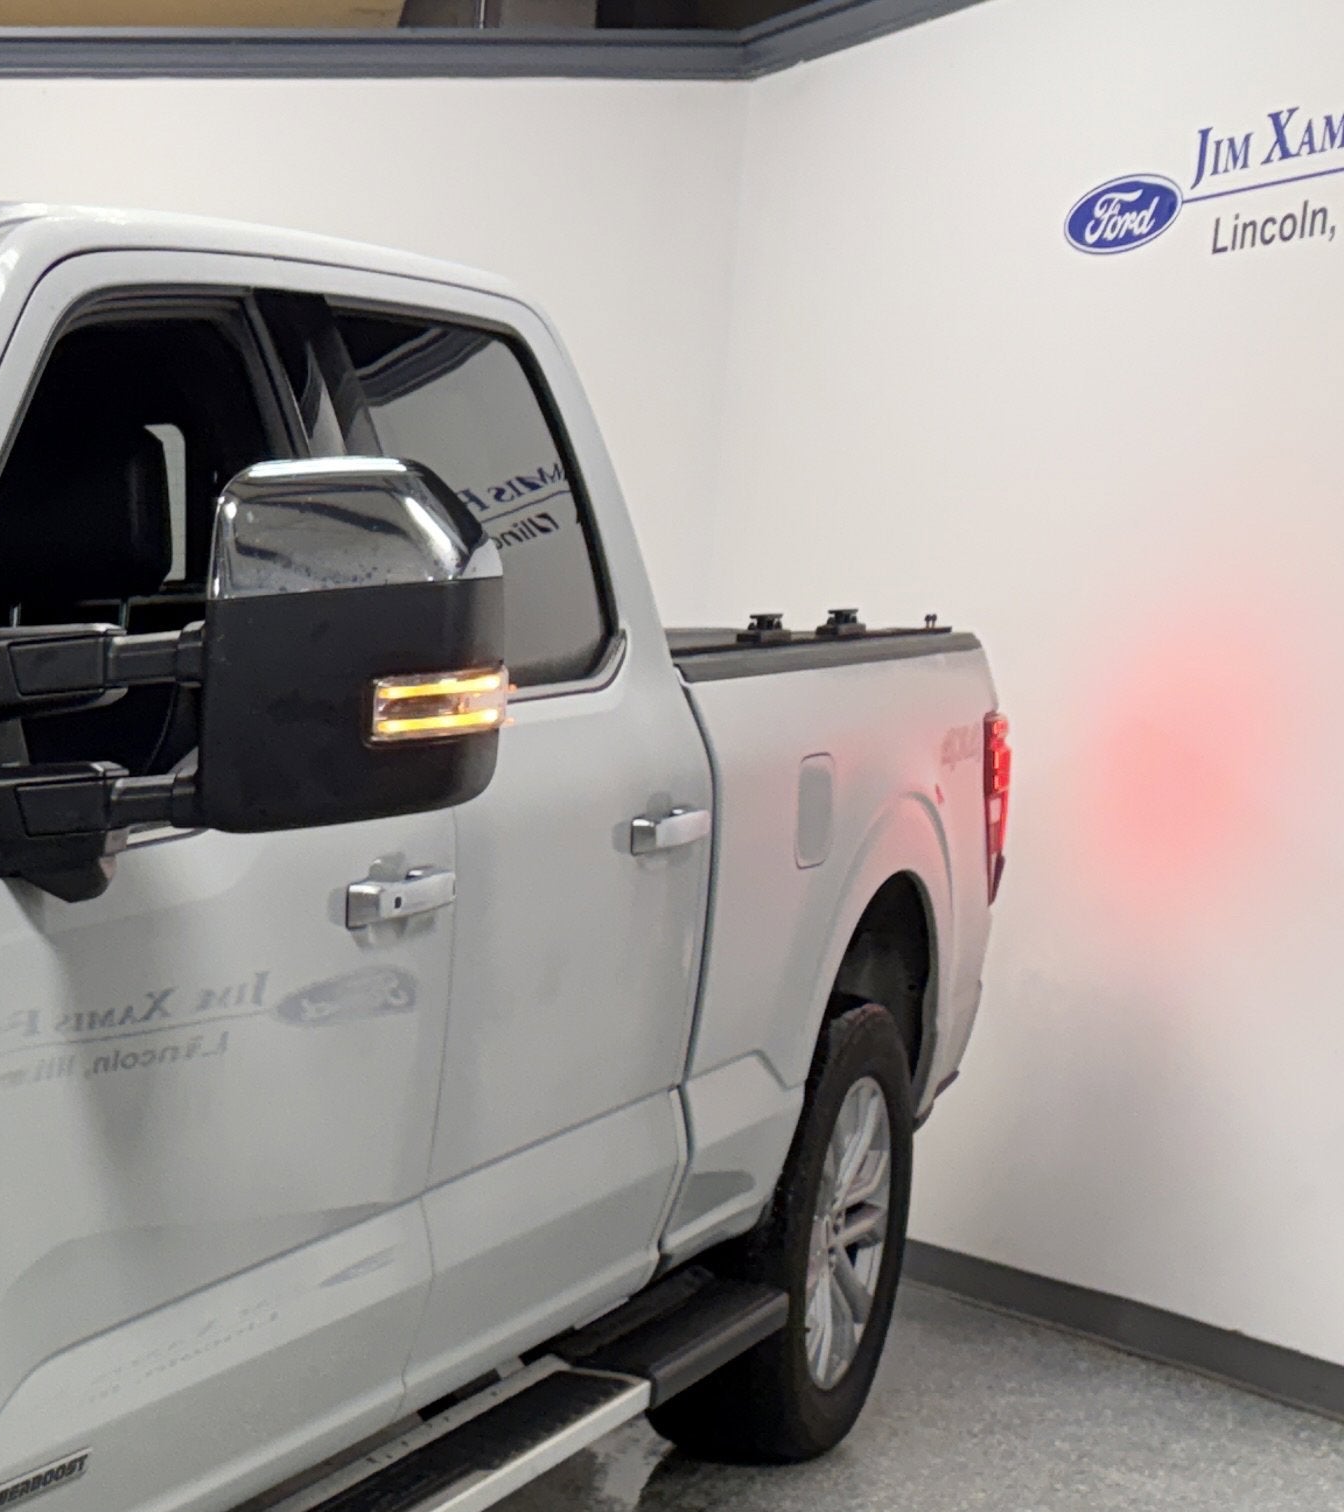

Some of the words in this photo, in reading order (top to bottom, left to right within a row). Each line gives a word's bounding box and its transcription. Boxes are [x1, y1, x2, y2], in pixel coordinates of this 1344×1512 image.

[1190, 126, 1255, 190] JIM
[1083, 188, 1161, 245] Ford
[1211, 199, 1337, 255] Lincoln,
